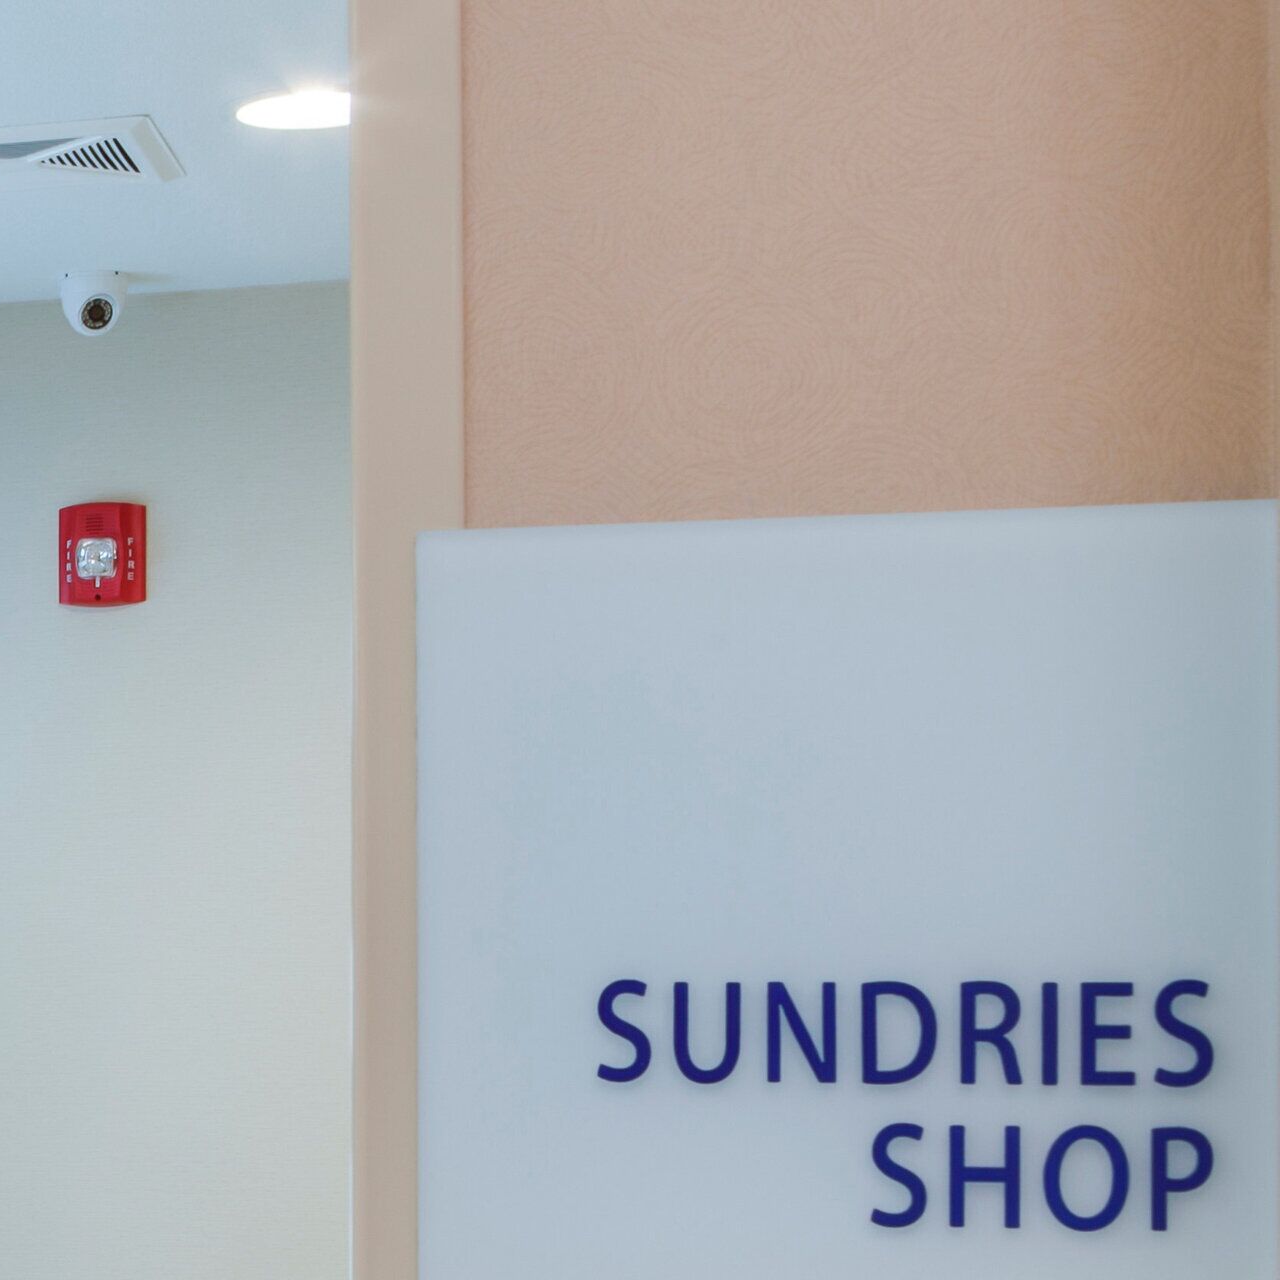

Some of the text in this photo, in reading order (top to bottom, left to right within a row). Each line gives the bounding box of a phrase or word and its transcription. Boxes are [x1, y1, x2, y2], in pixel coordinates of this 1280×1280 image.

[127, 537, 135, 581] FIRE
[596, 978, 1215, 1088] SUNDRIES
[870, 1122, 1214, 1232] SHOP
